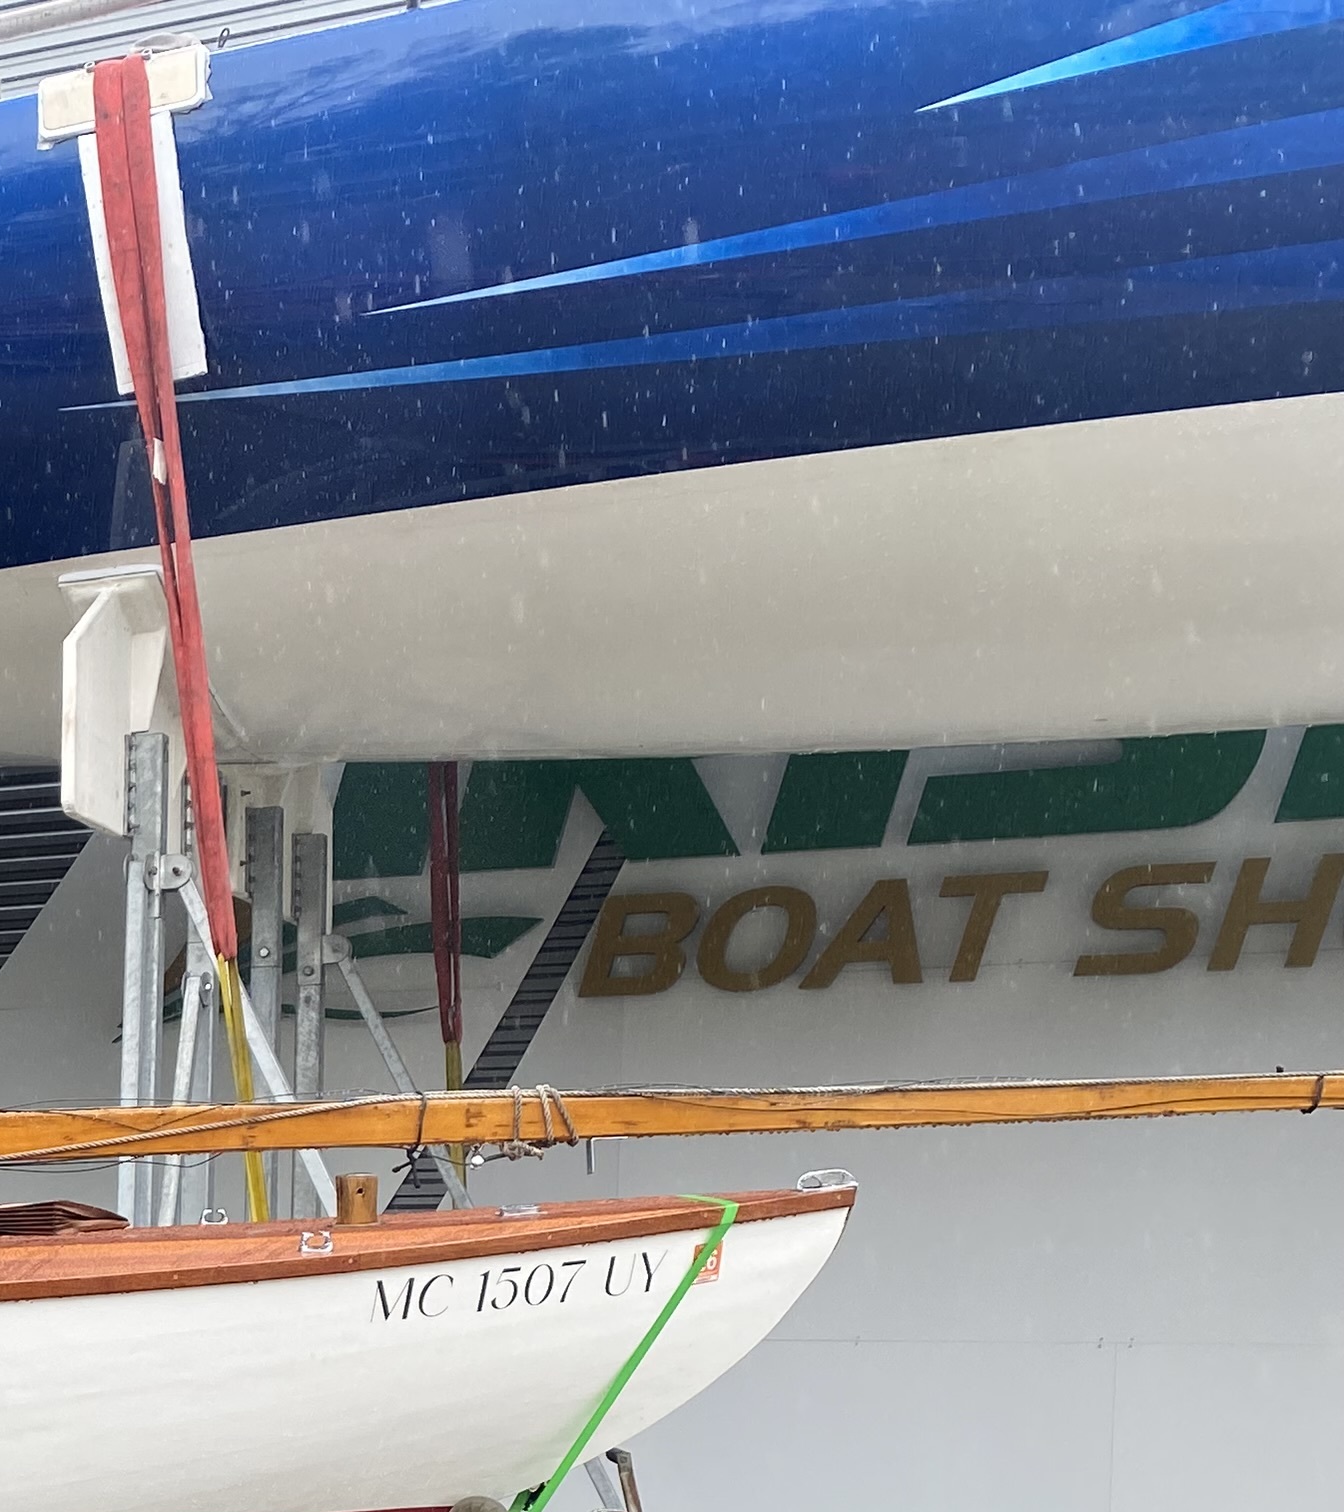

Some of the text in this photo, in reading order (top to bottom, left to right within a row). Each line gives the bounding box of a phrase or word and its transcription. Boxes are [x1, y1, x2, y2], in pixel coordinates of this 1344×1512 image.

[578, 852, 1344, 998] BOAT SH
[370, 1249, 669, 1323] MC 1507 UY
